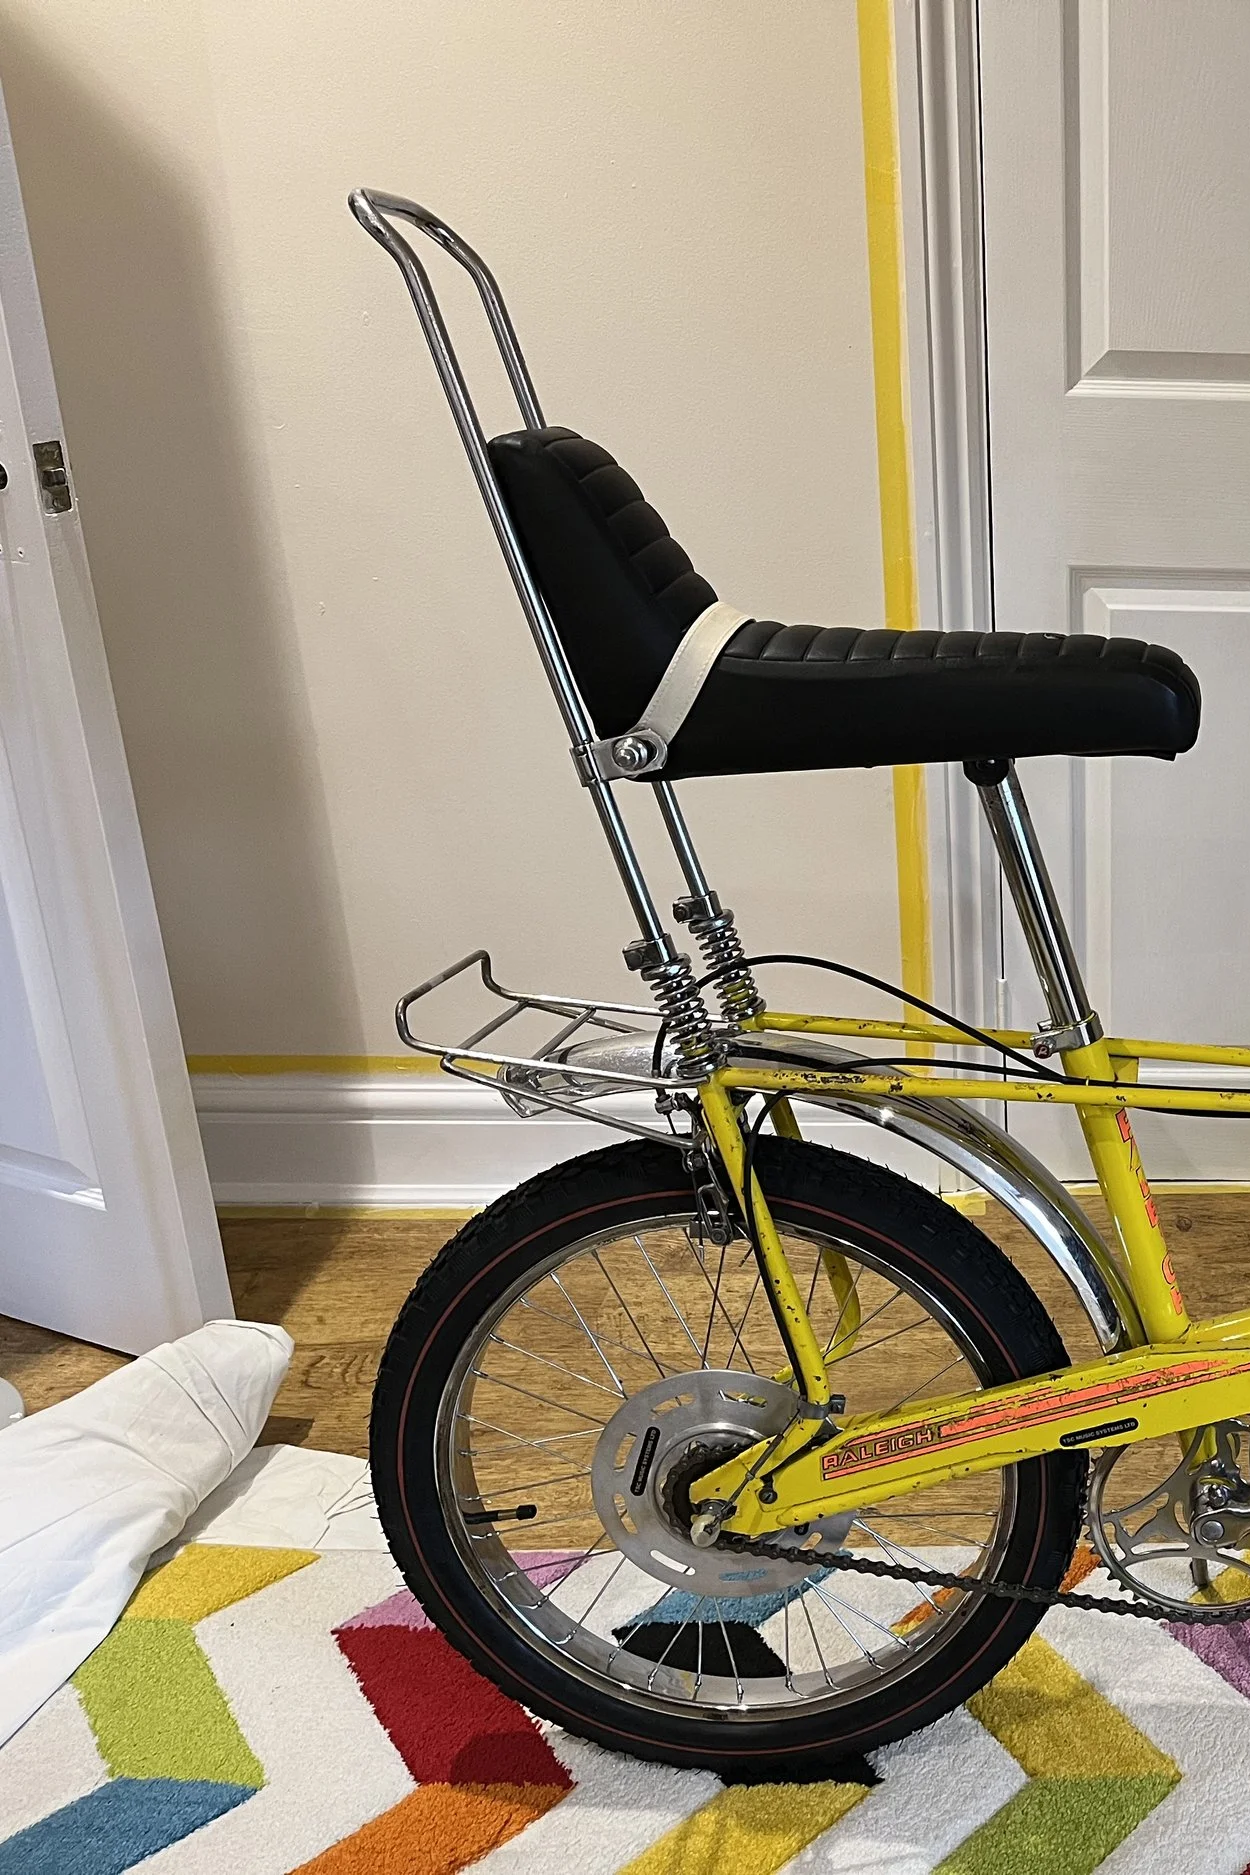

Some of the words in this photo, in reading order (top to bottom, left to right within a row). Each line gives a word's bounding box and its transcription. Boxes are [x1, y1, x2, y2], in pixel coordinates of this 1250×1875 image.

[1075, 1432, 1095, 1441] MUSIC
[1095, 1425, 1124, 1436] SYSTEMS
[1124, 1421, 1136, 1430] LTD
[822, 1428, 933, 1470] RALEIGH
